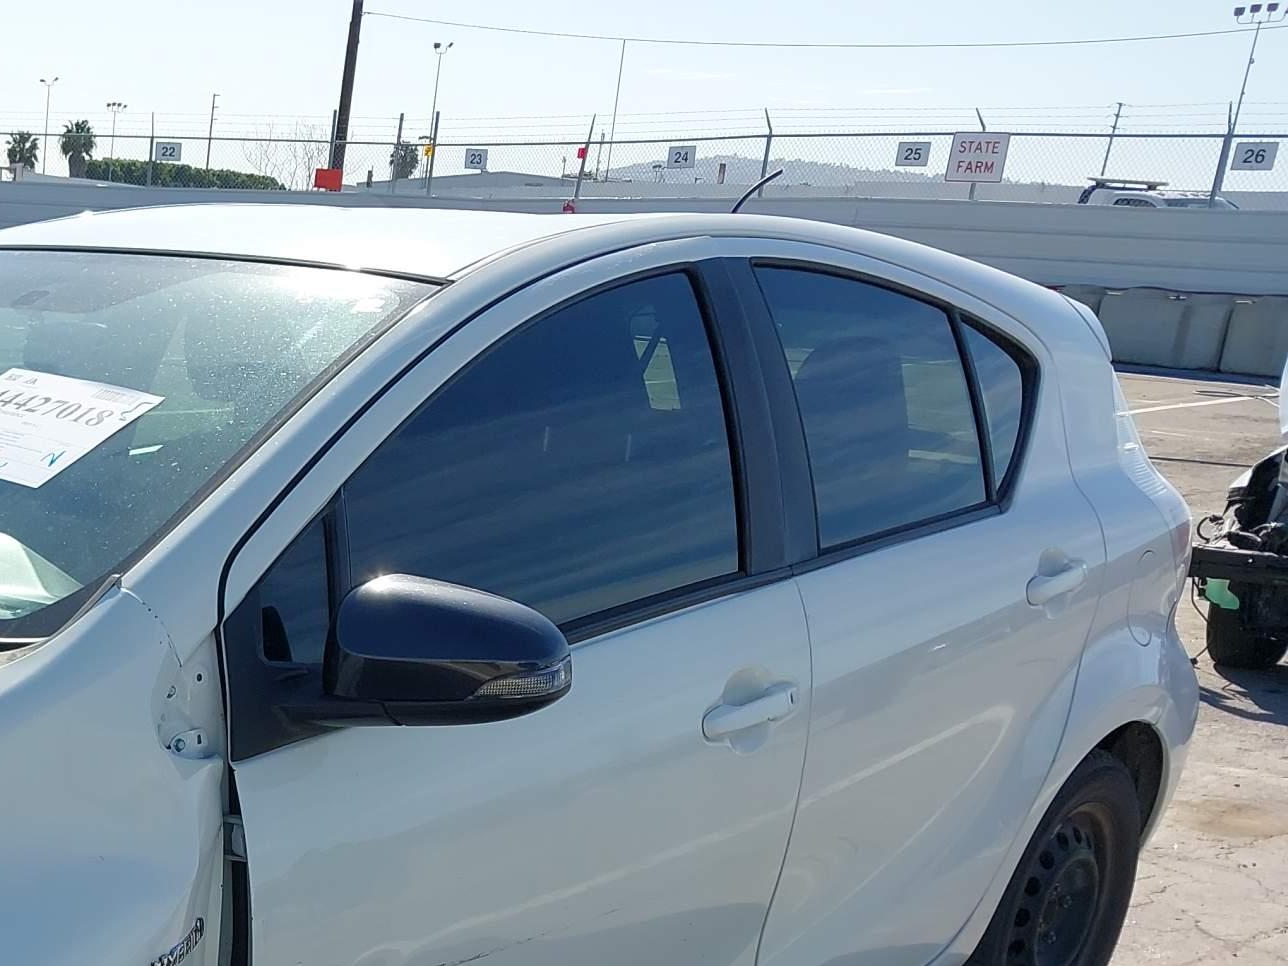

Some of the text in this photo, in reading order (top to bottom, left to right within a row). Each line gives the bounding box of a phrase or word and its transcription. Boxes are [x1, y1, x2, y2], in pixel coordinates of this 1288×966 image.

[161, 146, 176, 157] 22
[903, 147, 922, 161] 25
[958, 141, 1001, 154] STATE
[470, 153, 482, 165] 23
[674, 151, 689, 163] 24
[1242, 148, 1267, 164] 26
[956, 160, 995, 174] FARM
